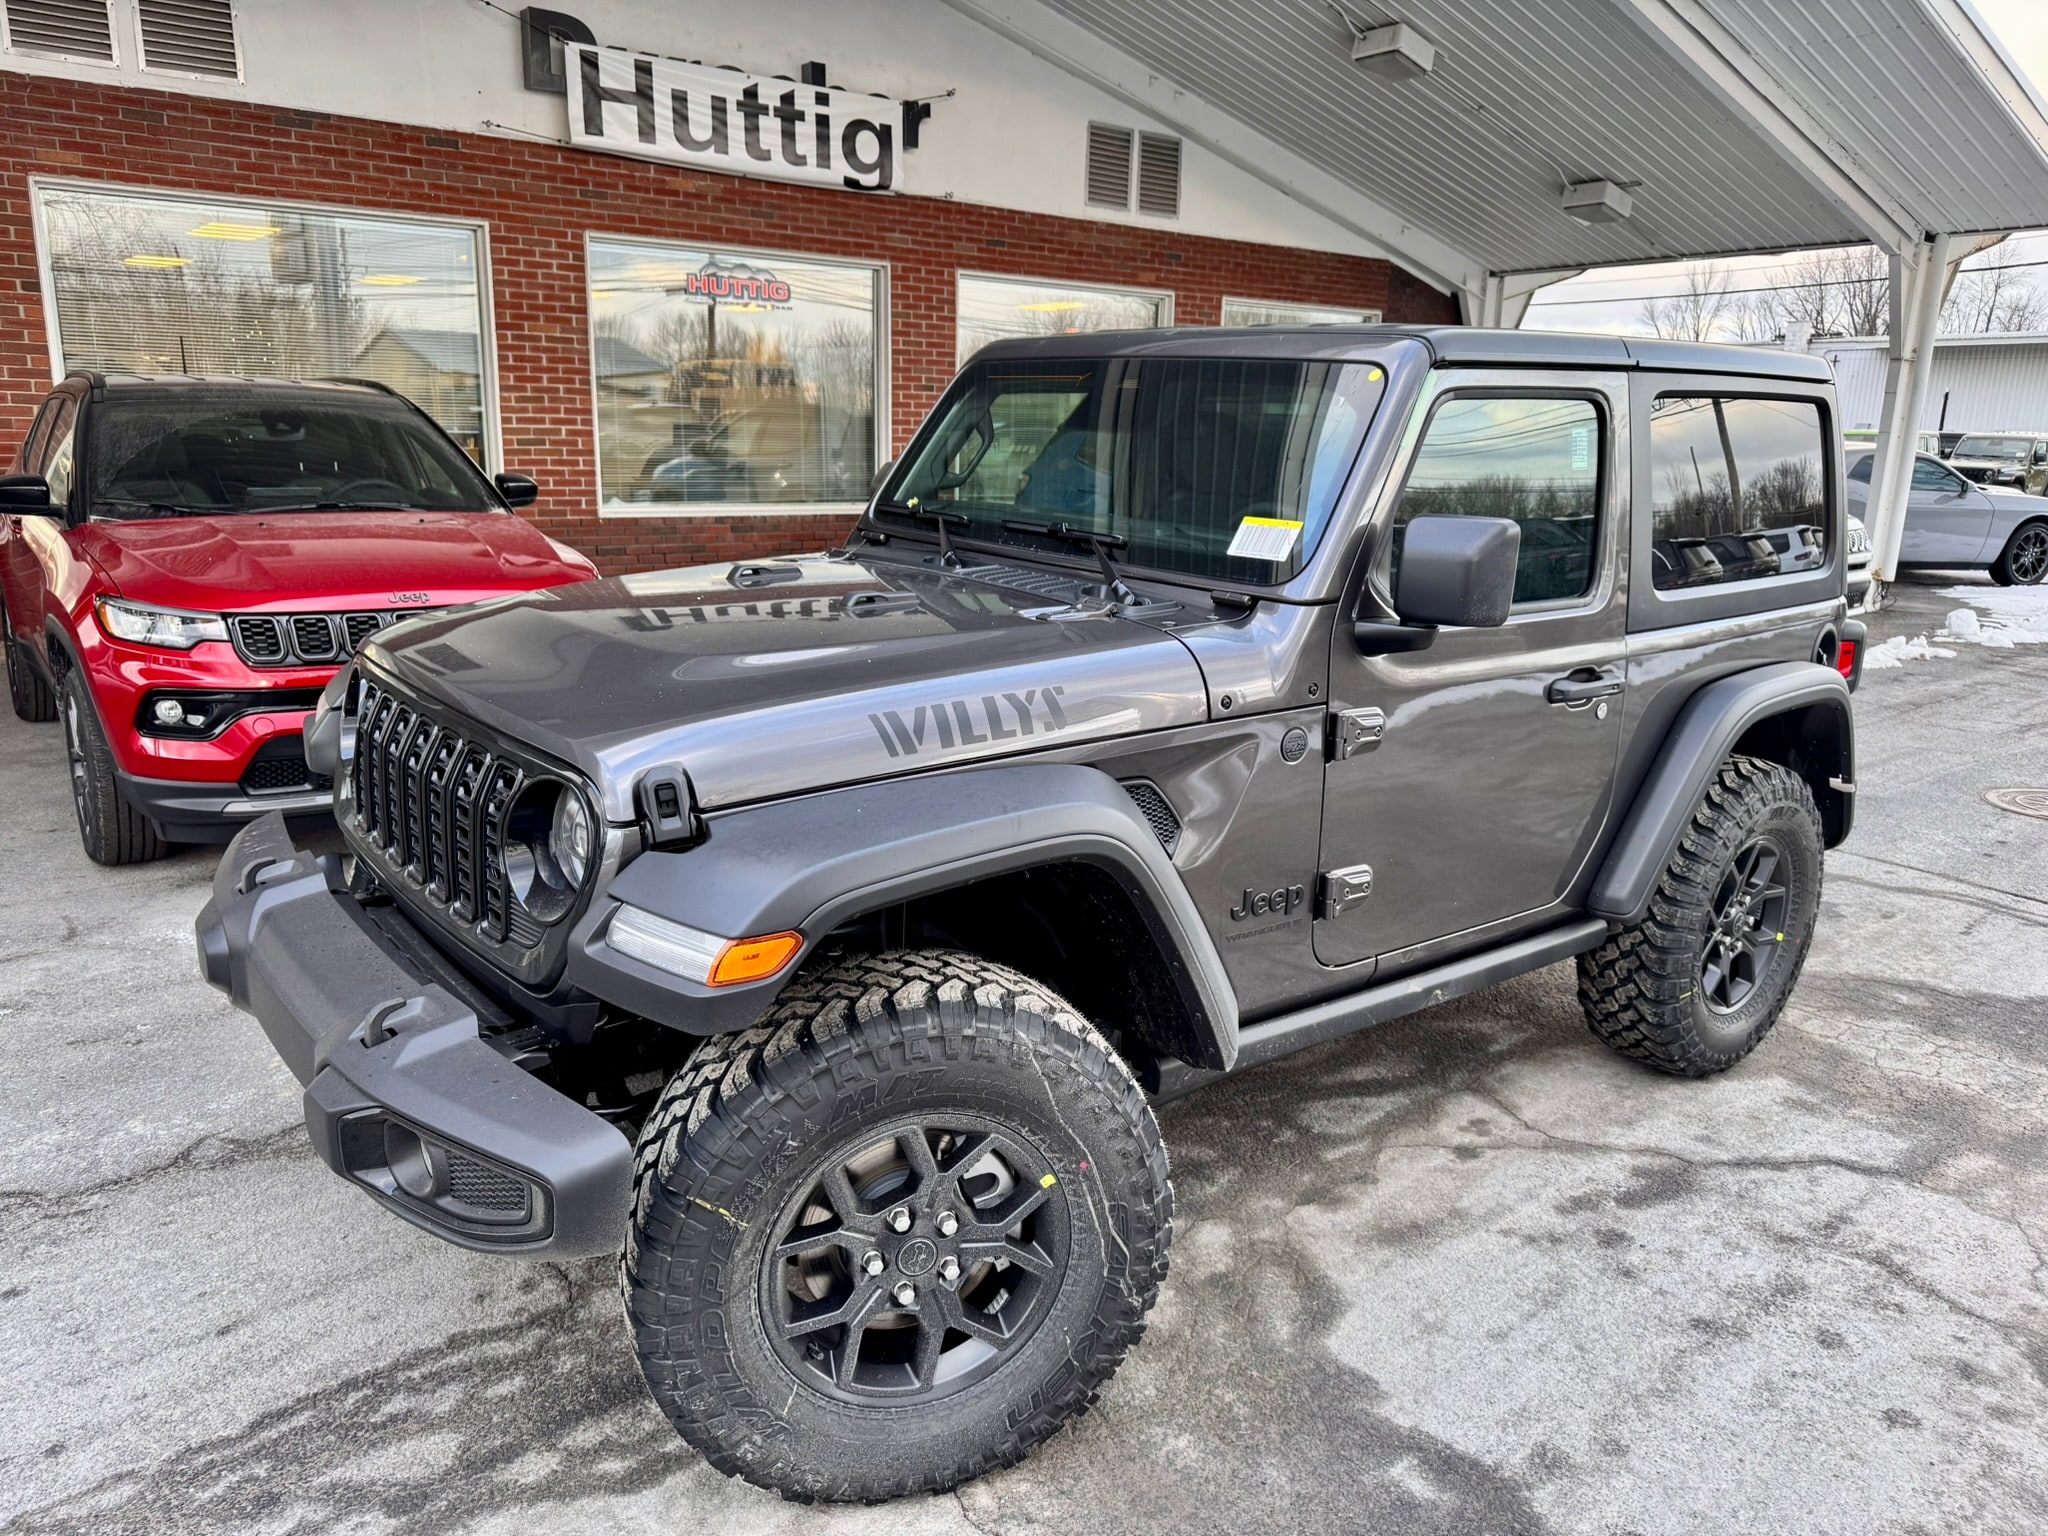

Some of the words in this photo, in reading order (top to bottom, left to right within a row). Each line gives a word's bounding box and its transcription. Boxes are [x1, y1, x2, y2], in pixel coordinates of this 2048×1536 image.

[579, 48, 893, 191] Huttig
[686, 273, 791, 302] HUTTIG
[388, 591, 431, 604] Jeep
[867, 686, 1067, 758] WILLYS
[1230, 884, 1304, 922] Jeep
[826, 1068, 947, 1133] M/T
